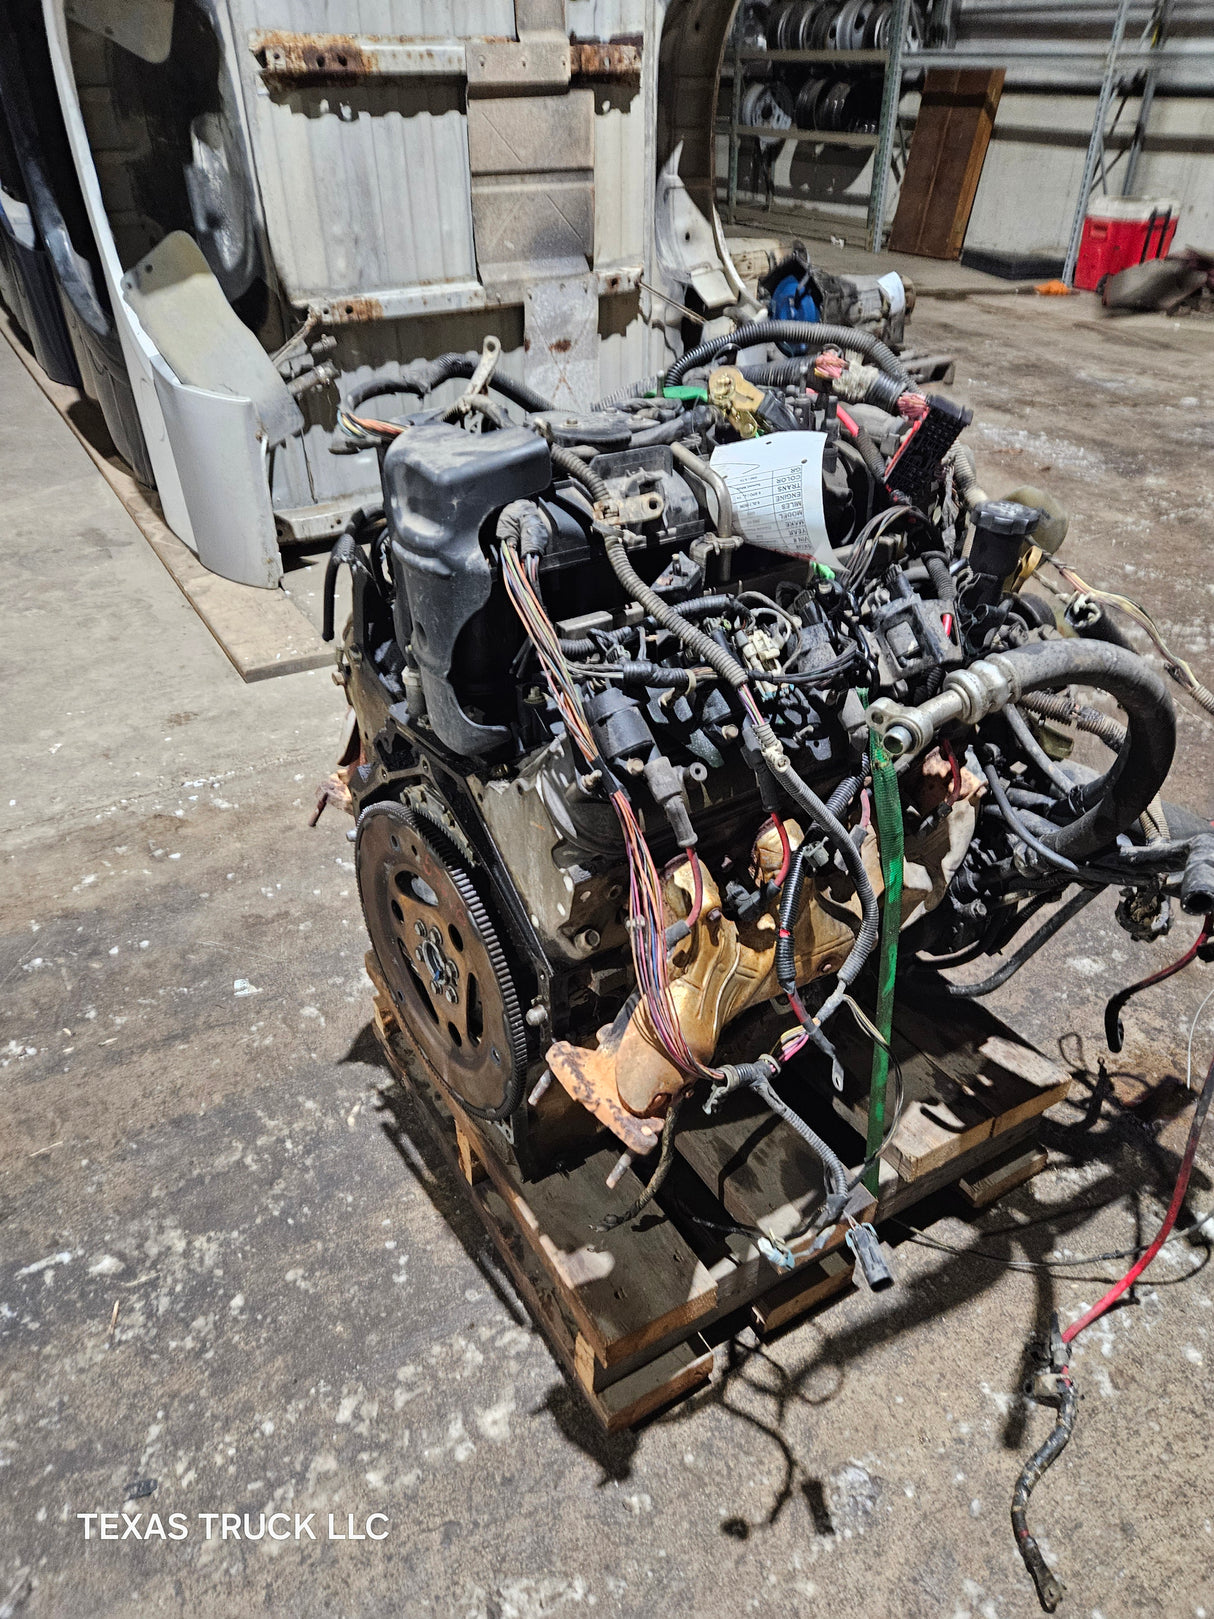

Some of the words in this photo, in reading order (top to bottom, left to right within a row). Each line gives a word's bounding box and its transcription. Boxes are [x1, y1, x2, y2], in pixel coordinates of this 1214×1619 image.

[776, 475, 801, 483] COLOR
[777, 483, 801, 492] TRANS
[776, 492, 801, 501] ENGINE
[781, 501, 802, 509] MILES
[778, 510, 803, 519] MODEL
